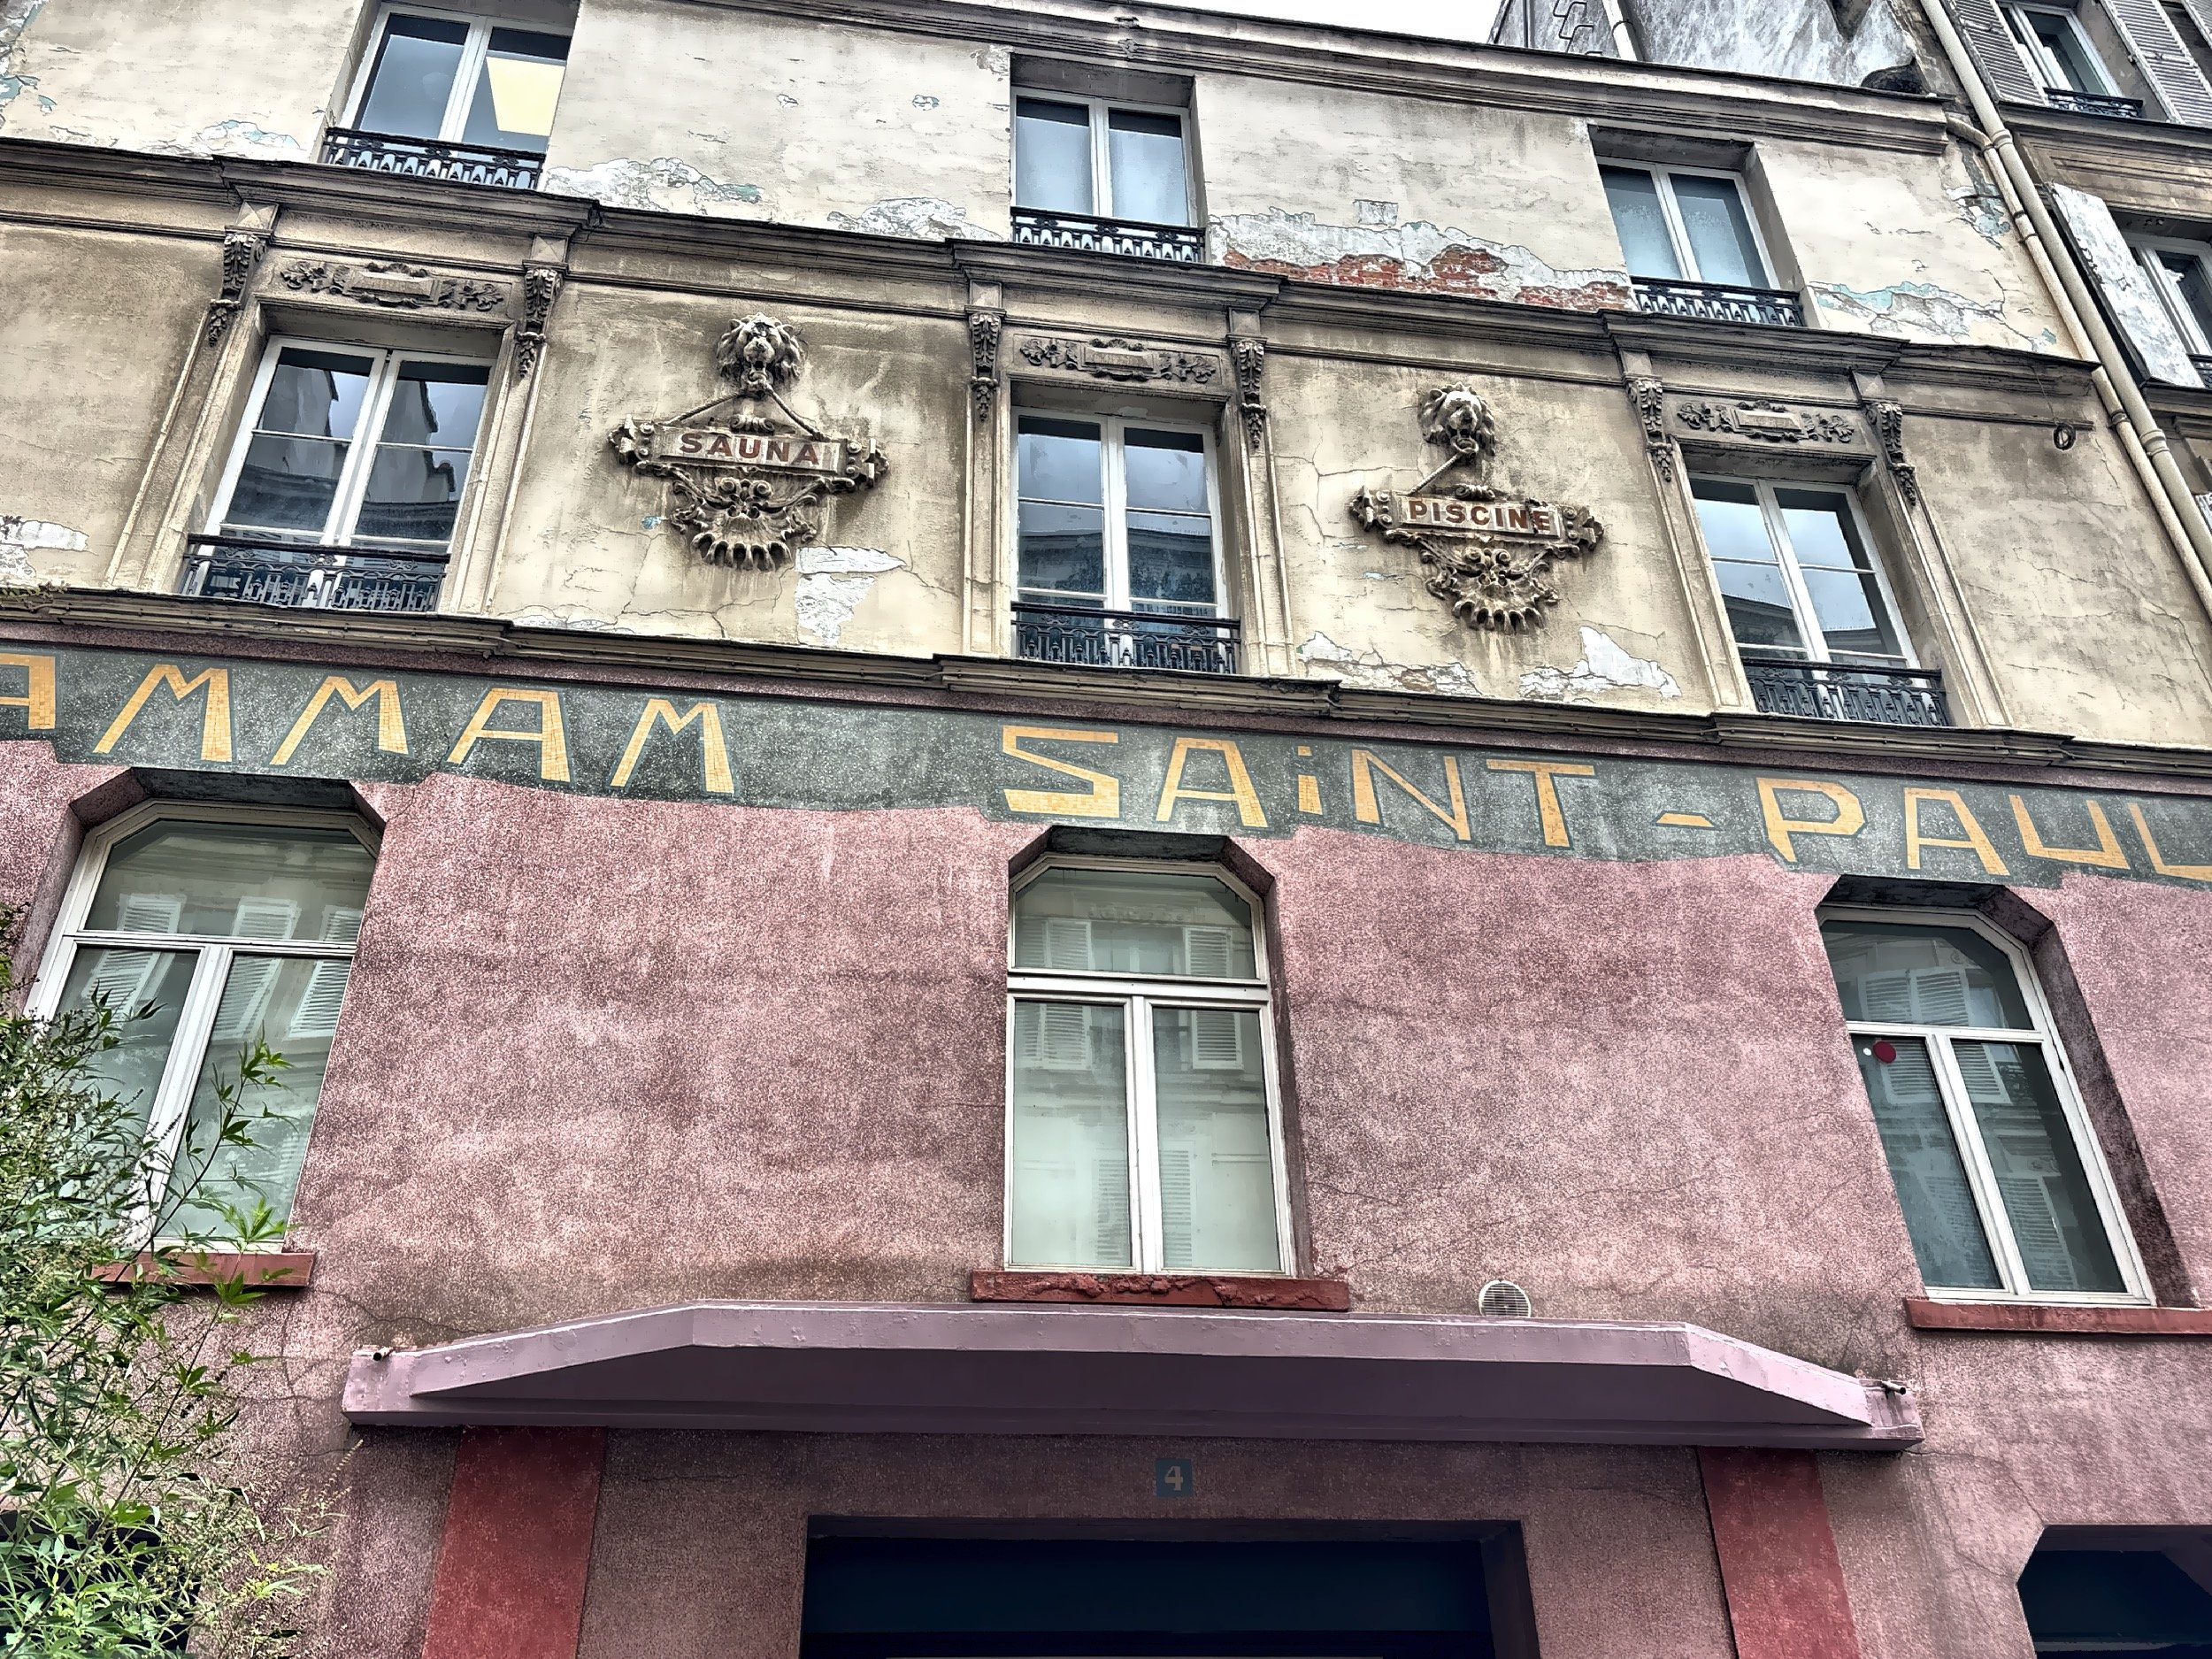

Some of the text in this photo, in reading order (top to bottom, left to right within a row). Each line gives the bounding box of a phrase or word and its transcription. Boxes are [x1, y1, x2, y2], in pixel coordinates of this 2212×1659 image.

[680, 433, 819, 465] SAUNA
[1409, 500, 1550, 531] PISCINE
[1164, 1466, 1184, 1491] 4
